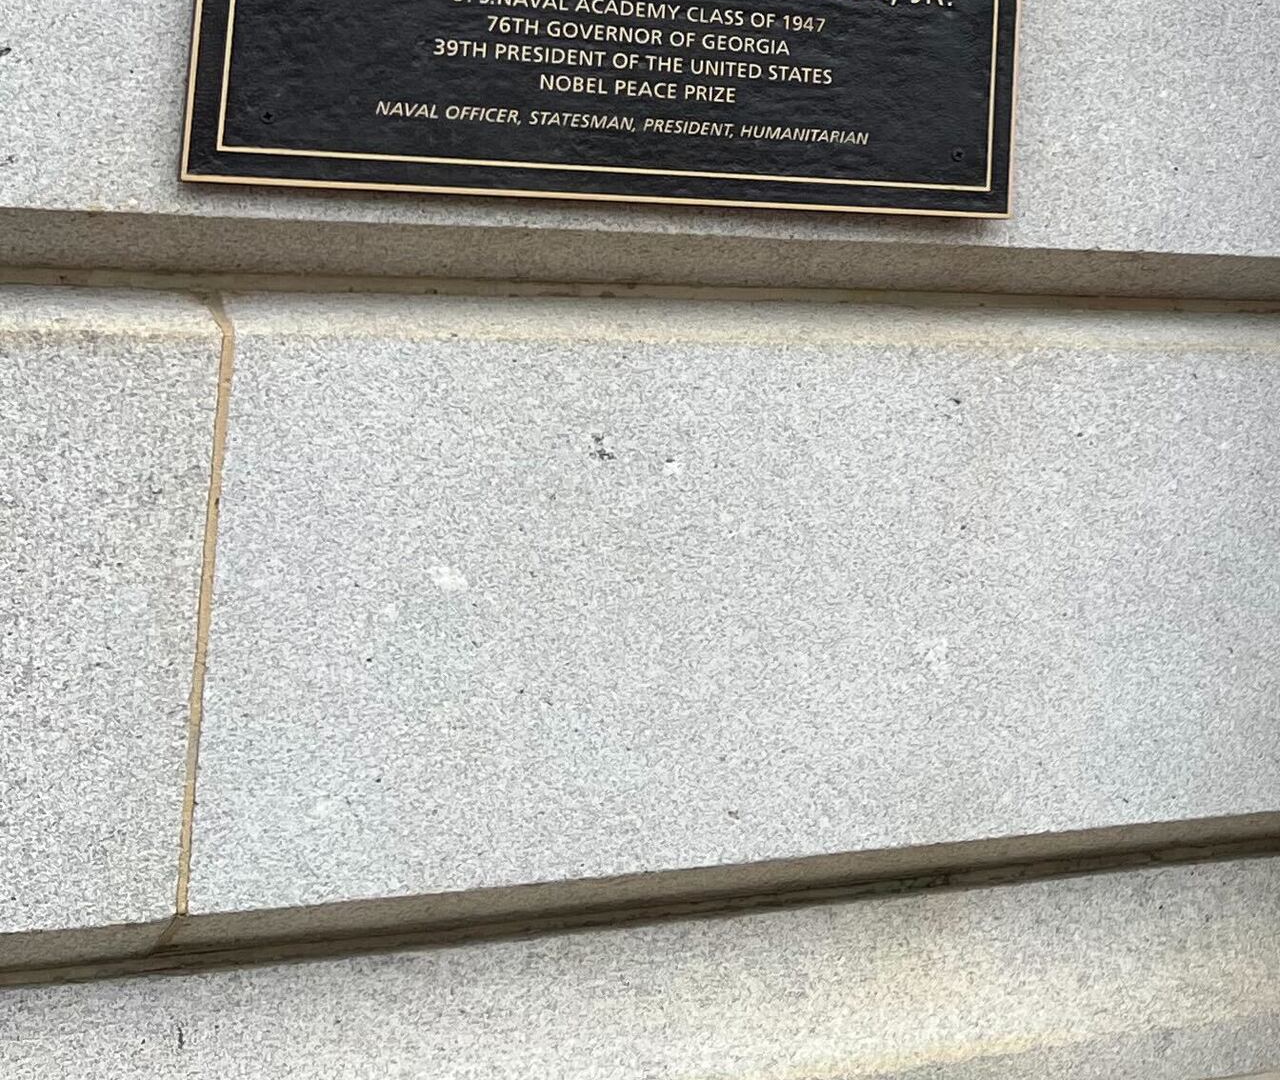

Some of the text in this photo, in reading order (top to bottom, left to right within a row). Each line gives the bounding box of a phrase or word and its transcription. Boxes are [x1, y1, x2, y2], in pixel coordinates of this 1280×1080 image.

[487, 15, 791, 56] 76TH GOVERNOR OF GEORGIA
[686, 6, 744, 27] CLASS
[750, 11, 776, 29] OF
[782, 14, 826, 33] 1947
[432, 38, 833, 85] 39TH PRESIDENT OF THE UNITED STATES
[539, 73, 737, 104] NOBEL PEACE PRIZE
[375, 100, 870, 146] NAVAL OFFICER, STATESMAN, PRESIDENT, HUMANITARIAN
